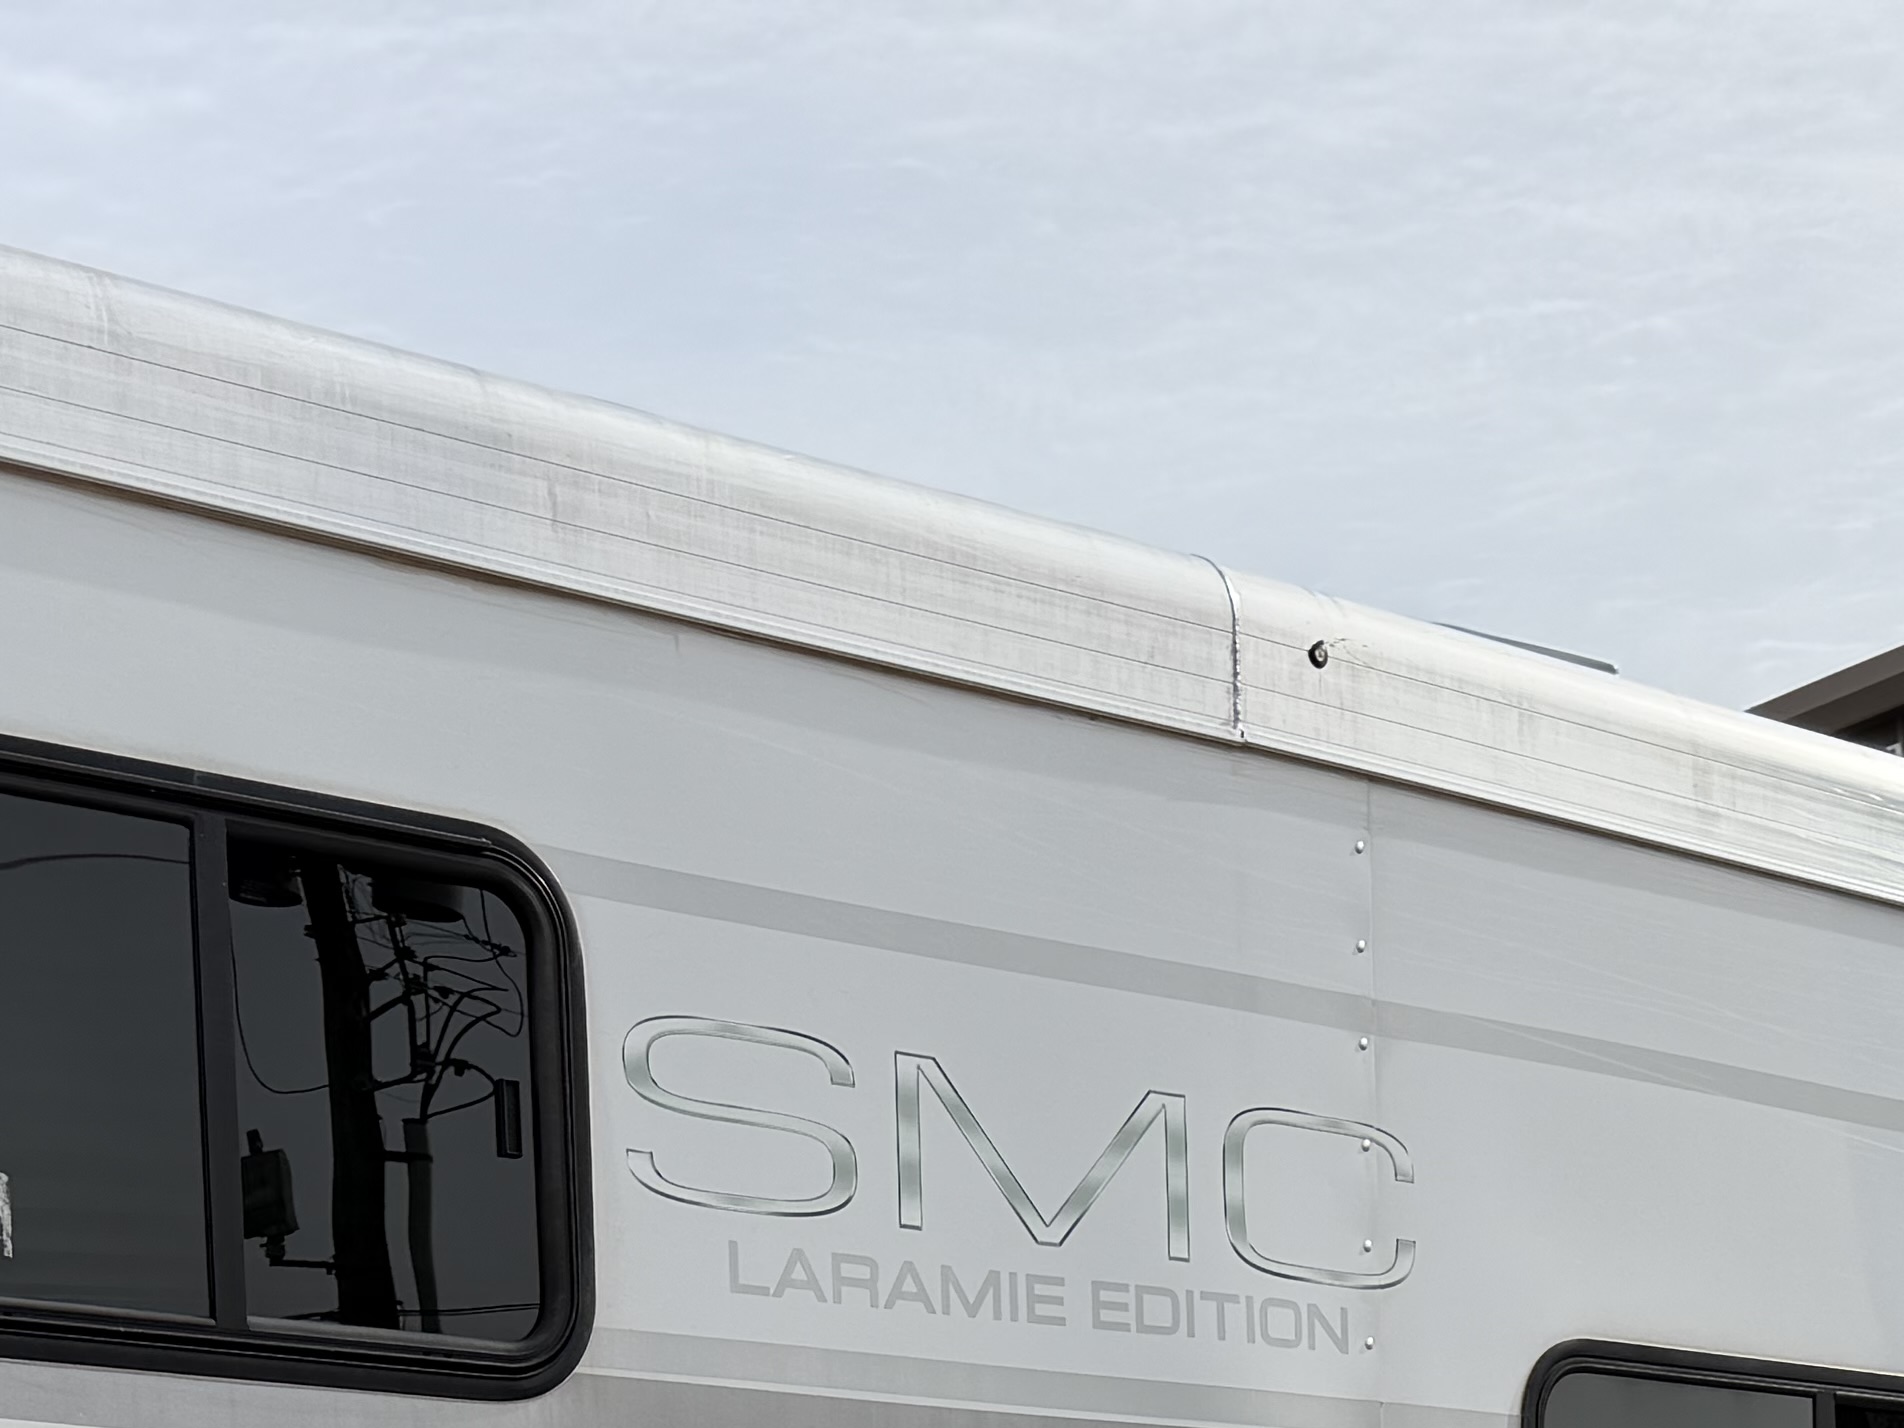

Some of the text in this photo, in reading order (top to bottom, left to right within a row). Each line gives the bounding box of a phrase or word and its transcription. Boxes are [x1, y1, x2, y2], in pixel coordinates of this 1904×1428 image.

[621, 1013, 1417, 1291] SMC
[728, 1238, 1350, 1355] LARAMIE EDITION
